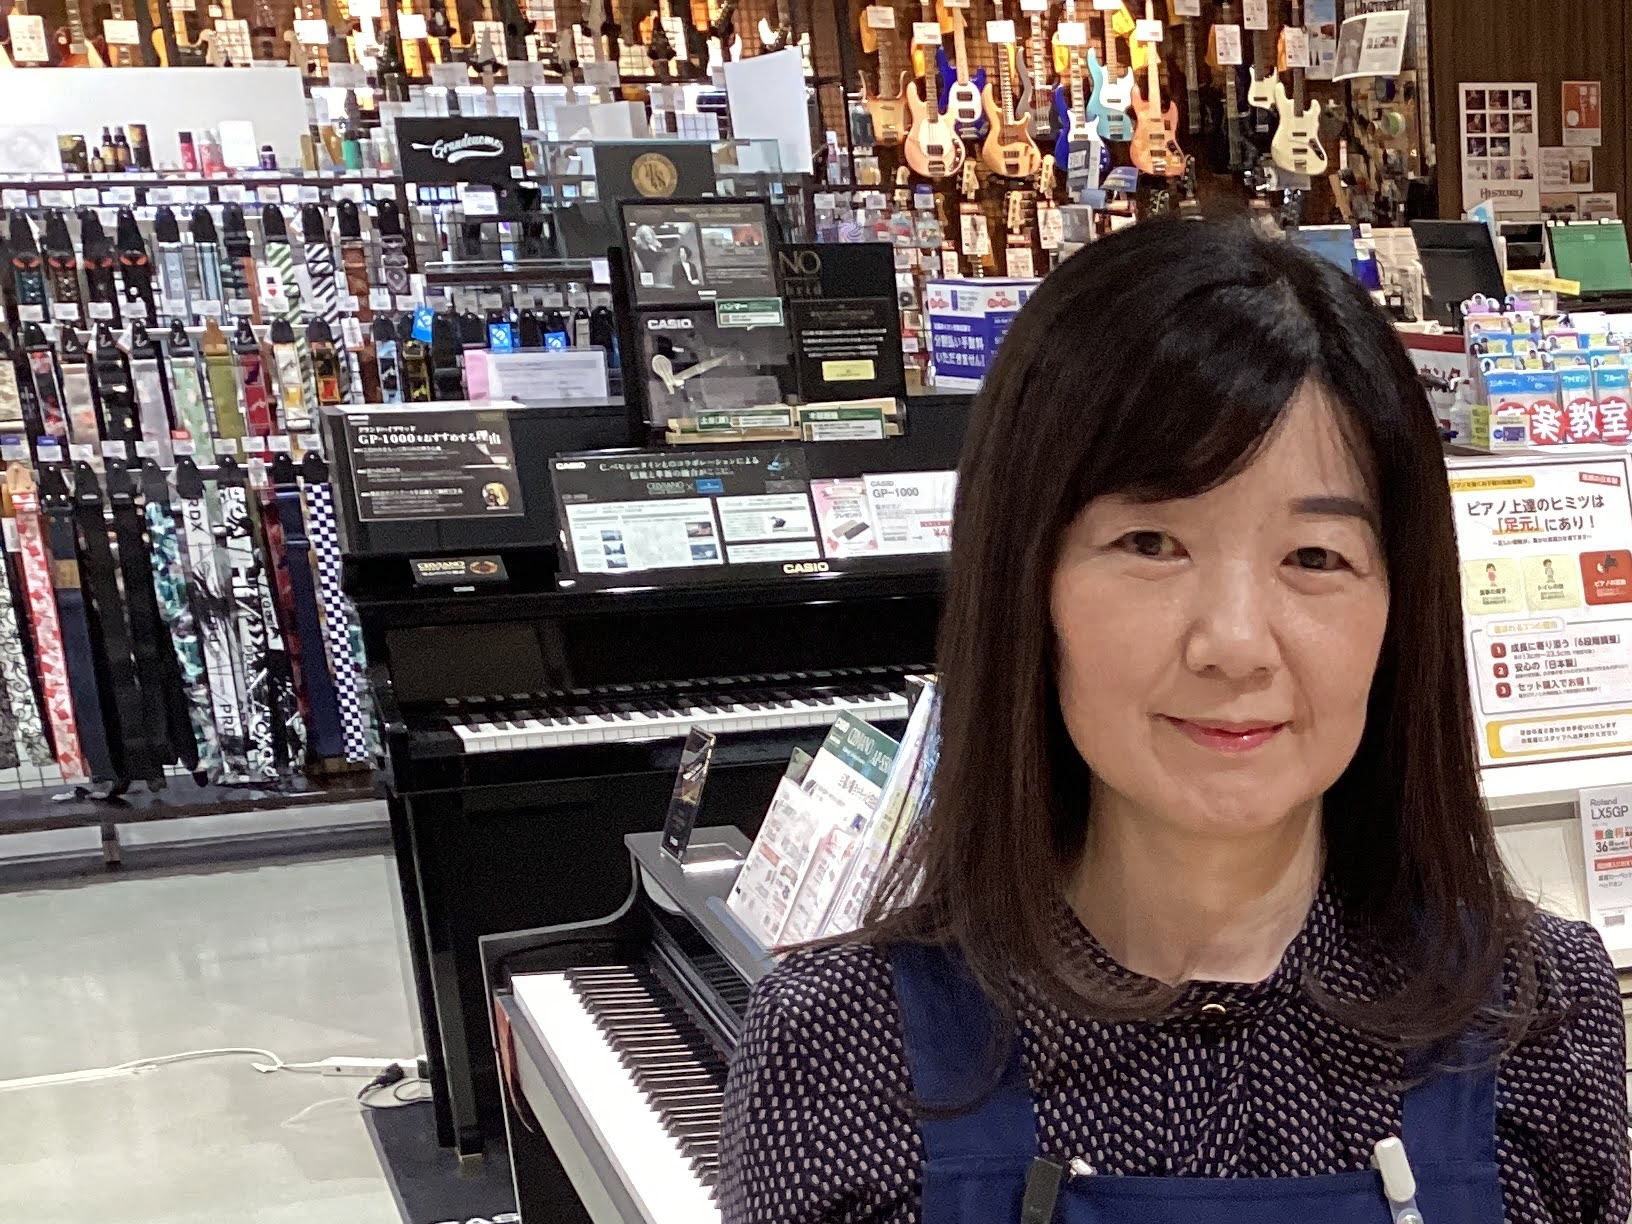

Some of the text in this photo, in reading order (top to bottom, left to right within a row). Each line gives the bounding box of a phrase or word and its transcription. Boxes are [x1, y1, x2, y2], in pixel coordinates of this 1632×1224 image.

[647, 318, 694, 330] CASIO
[872, 487, 919, 498] GP-1000
[1467, 494, 1605, 517] ピアノ上達のヒミツは
[783, 561, 830, 574] CASIO
[1590, 805, 1629, 820] LX5GP
